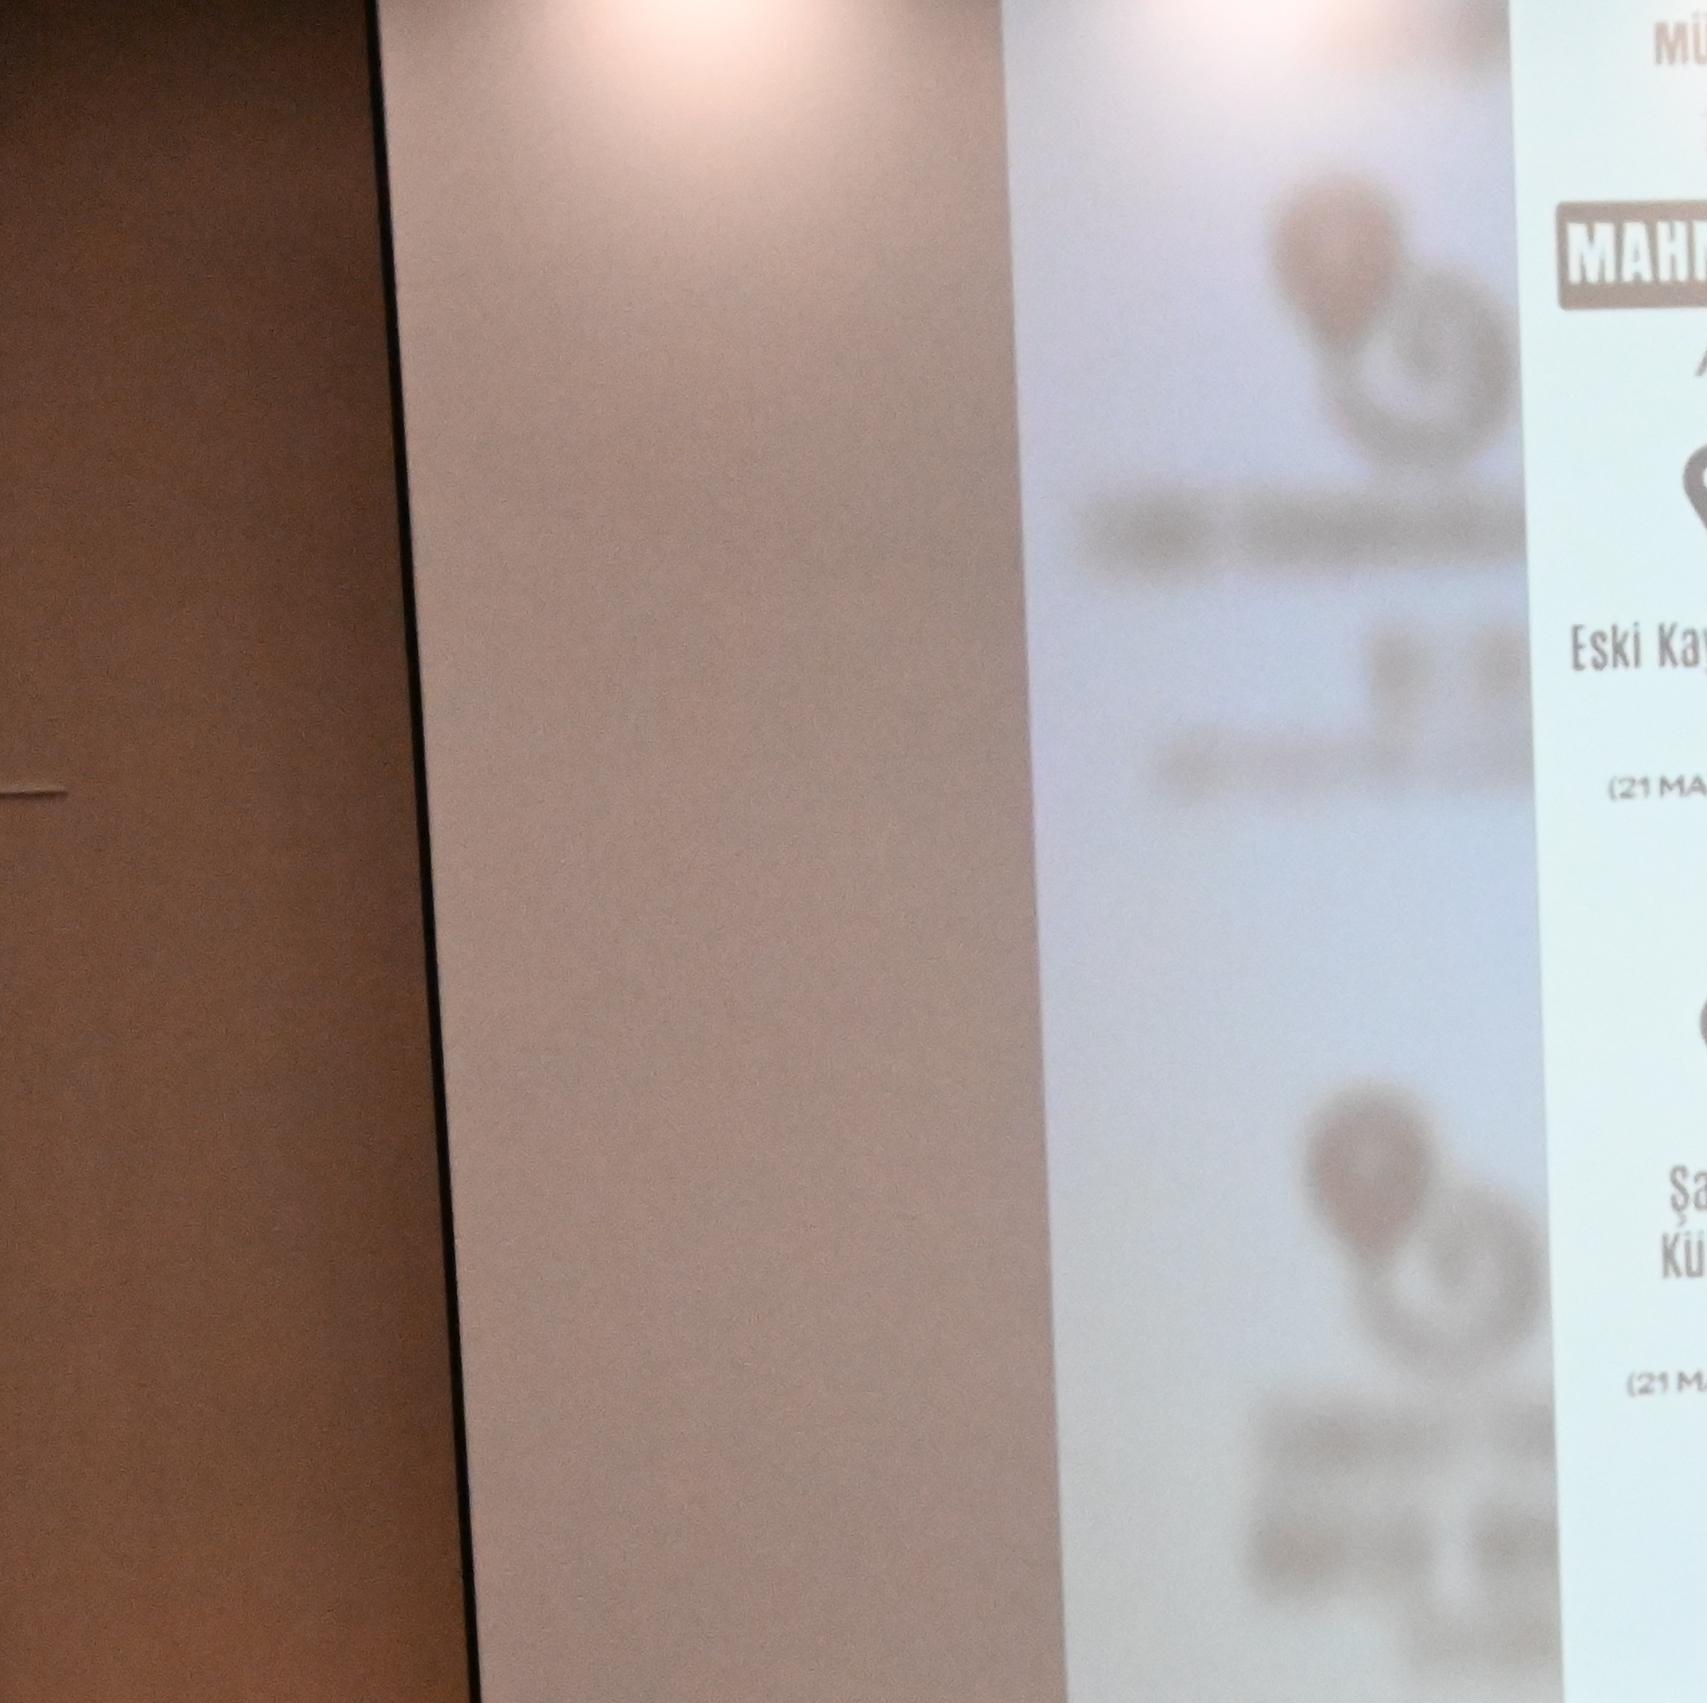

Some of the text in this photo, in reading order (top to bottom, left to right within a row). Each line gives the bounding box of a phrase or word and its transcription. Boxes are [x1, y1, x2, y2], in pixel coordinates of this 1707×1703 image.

[1571, 622, 1642, 671] Eski
[1608, 776, 1652, 801] (21
[1626, 1372, 1668, 1398] (21
